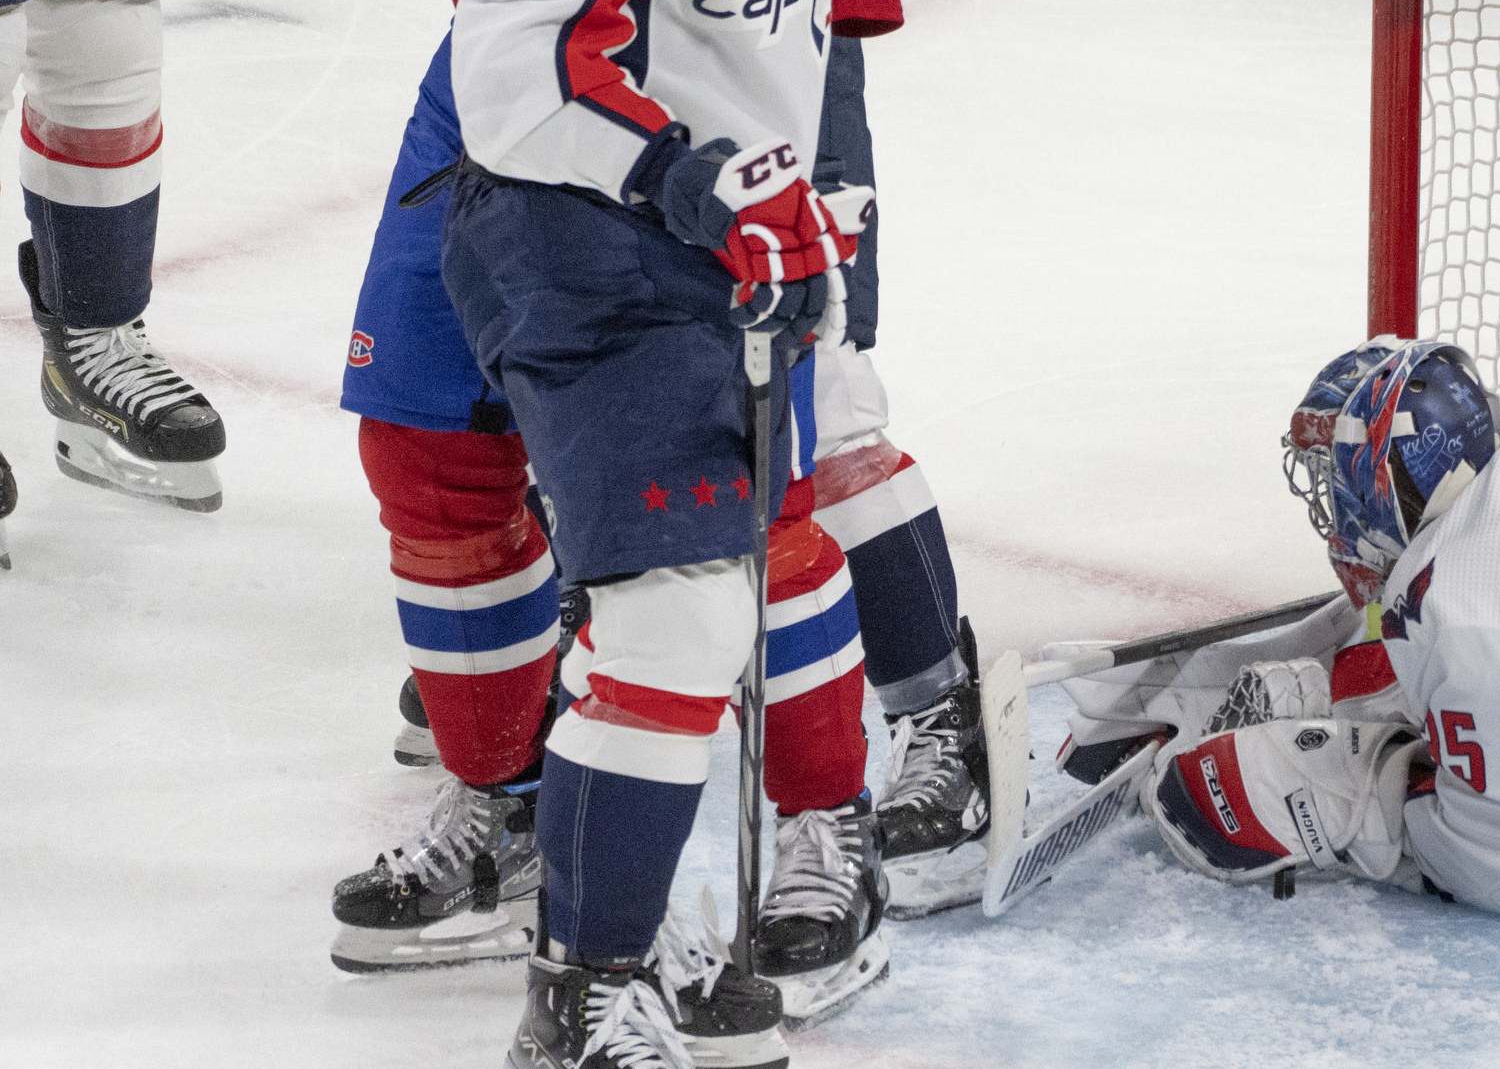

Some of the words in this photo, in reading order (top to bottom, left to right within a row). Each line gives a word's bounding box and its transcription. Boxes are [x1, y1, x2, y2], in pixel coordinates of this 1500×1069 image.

[735, 143, 798, 190] CC
[78, 404, 121, 434] CCM
[1297, 800, 1323, 854] VAUGHN
[443, 886, 477, 912] BAU
